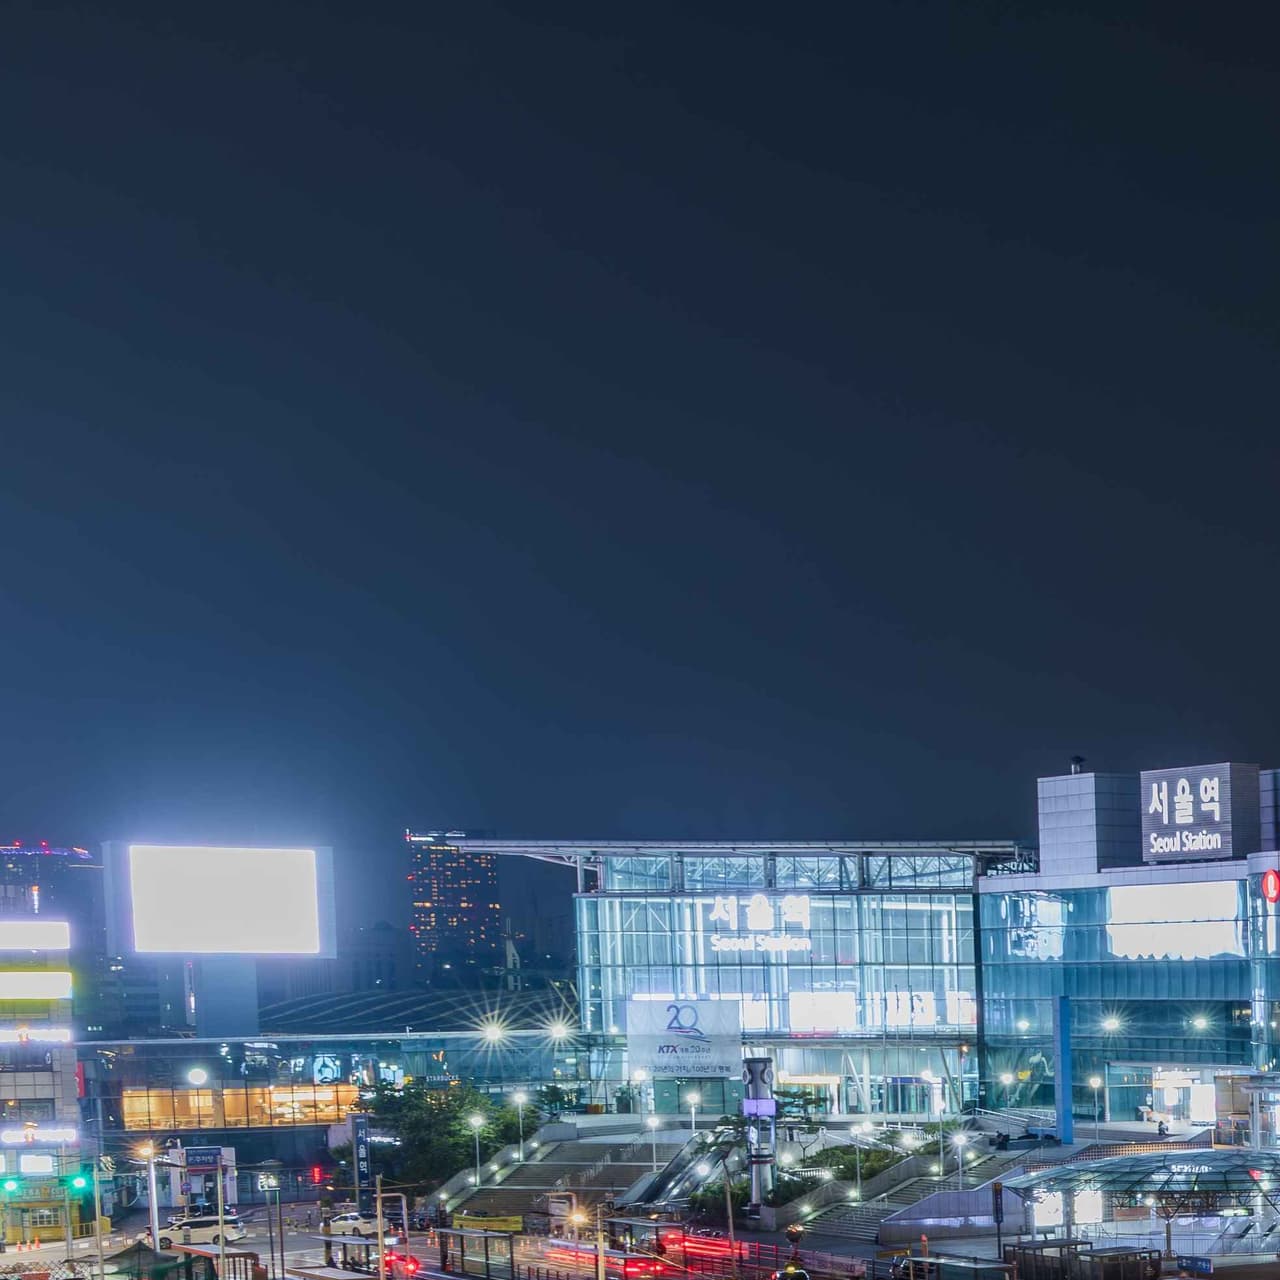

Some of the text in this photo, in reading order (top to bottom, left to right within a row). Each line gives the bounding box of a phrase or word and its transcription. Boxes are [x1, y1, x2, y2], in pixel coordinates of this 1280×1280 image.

[1149, 777, 1220, 825] 서울역
[1149, 829, 1222, 853] Seoul Station
[708, 894, 812, 931] 서울역
[710, 934, 812, 952] Seoul Station
[657, 1044, 679, 1054] KTX
